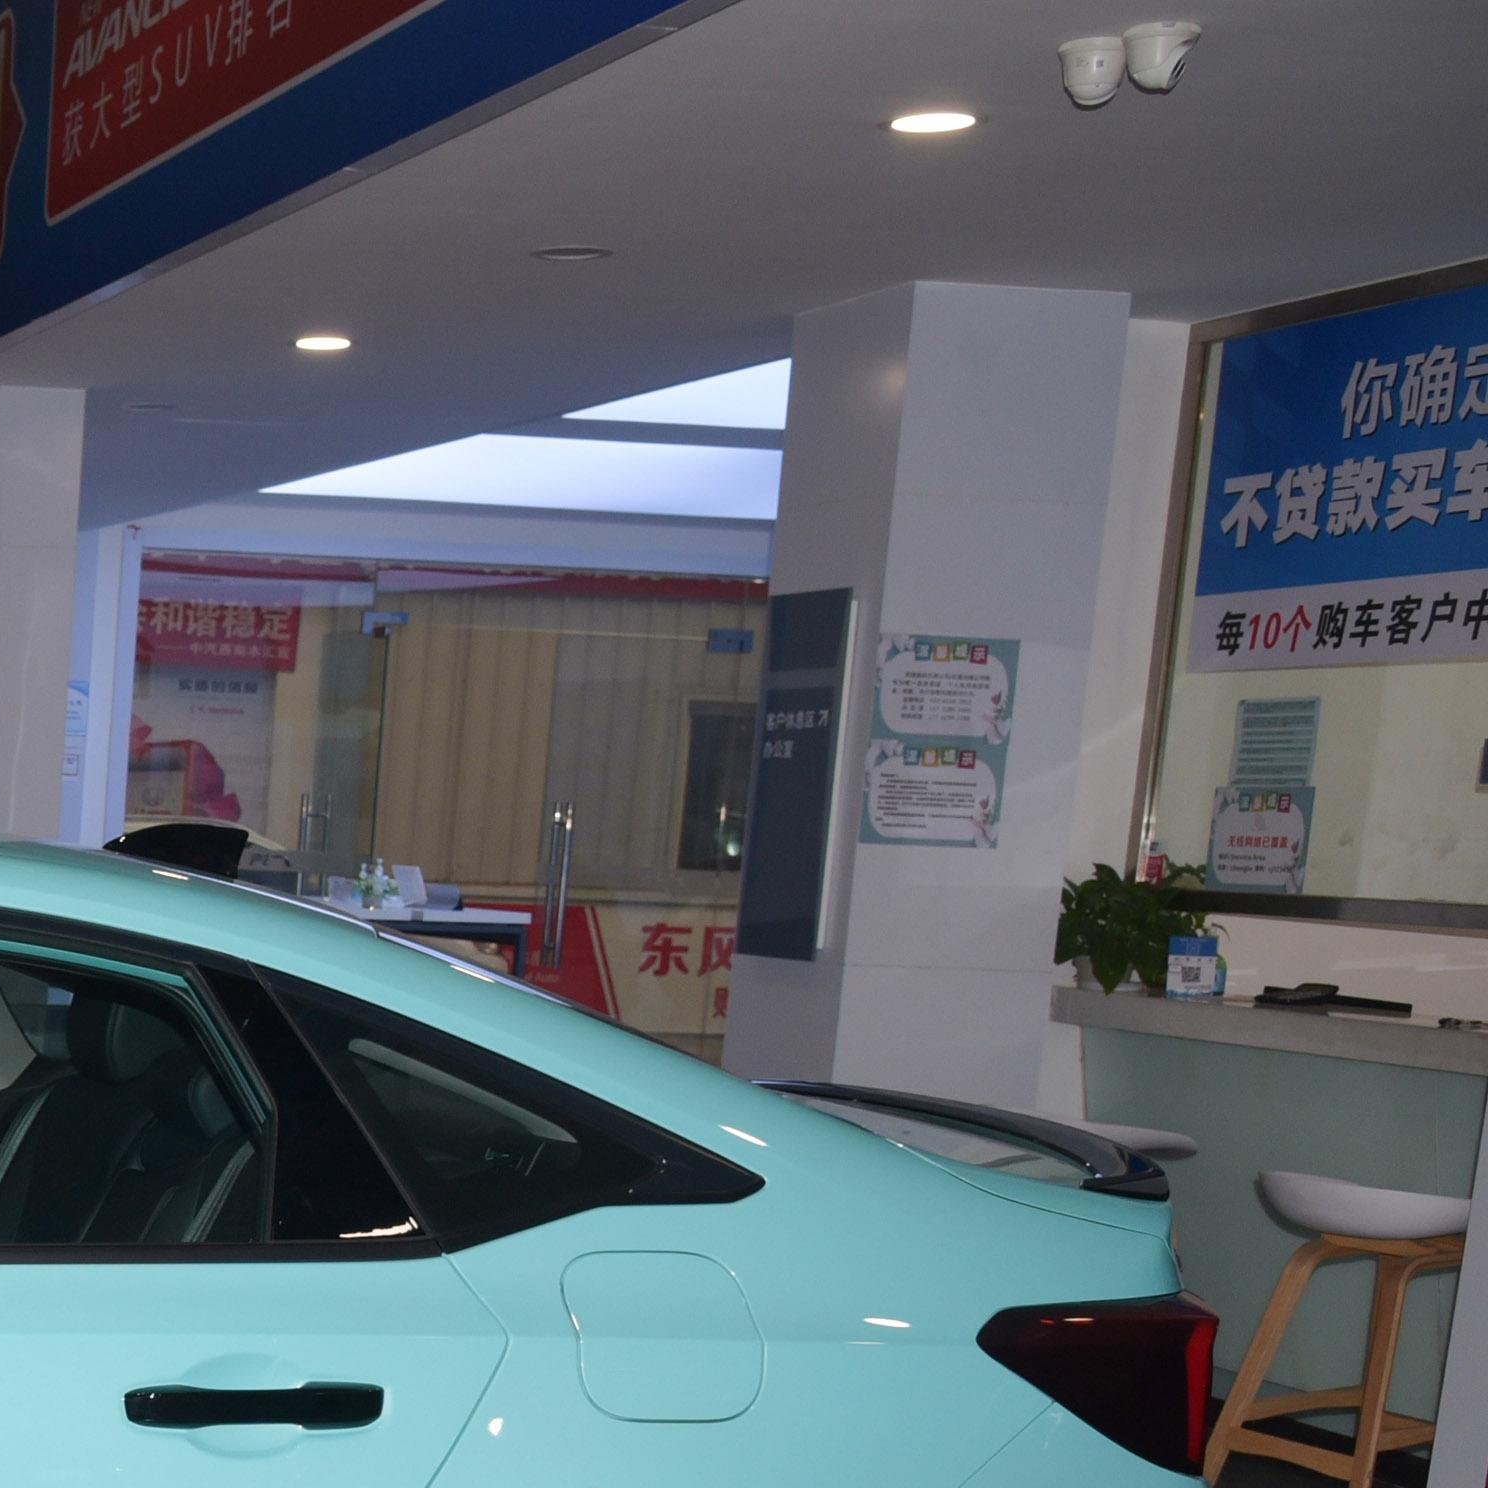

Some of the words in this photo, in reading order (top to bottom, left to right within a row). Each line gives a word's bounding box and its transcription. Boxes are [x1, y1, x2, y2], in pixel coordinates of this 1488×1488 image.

[1220, 438, 1488, 549] 不贷款买车
